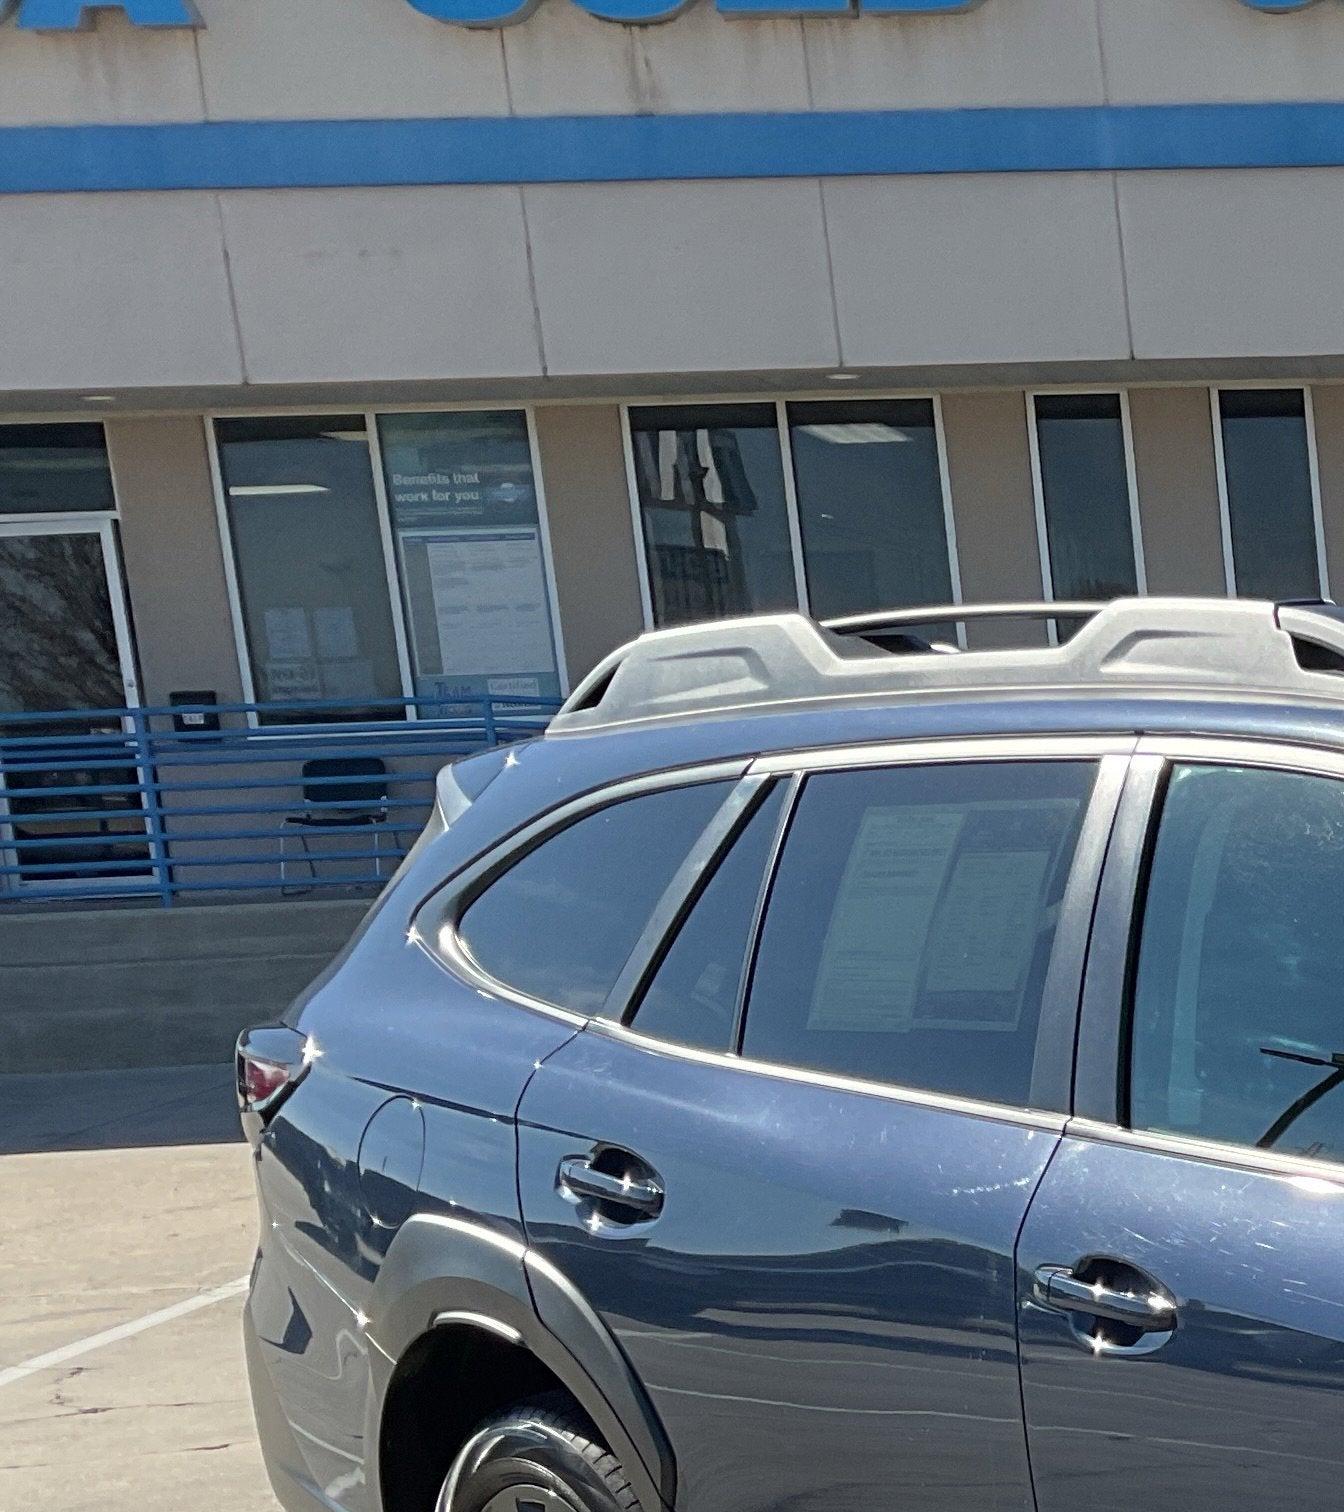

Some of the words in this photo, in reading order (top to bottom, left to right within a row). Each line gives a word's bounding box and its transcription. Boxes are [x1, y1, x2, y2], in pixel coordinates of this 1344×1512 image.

[393, 474, 450, 485] Benefits
[453, 472, 480, 484] that
[395, 492, 429, 502] work
[432, 489, 451, 502] for
[454, 491, 480, 504] you
